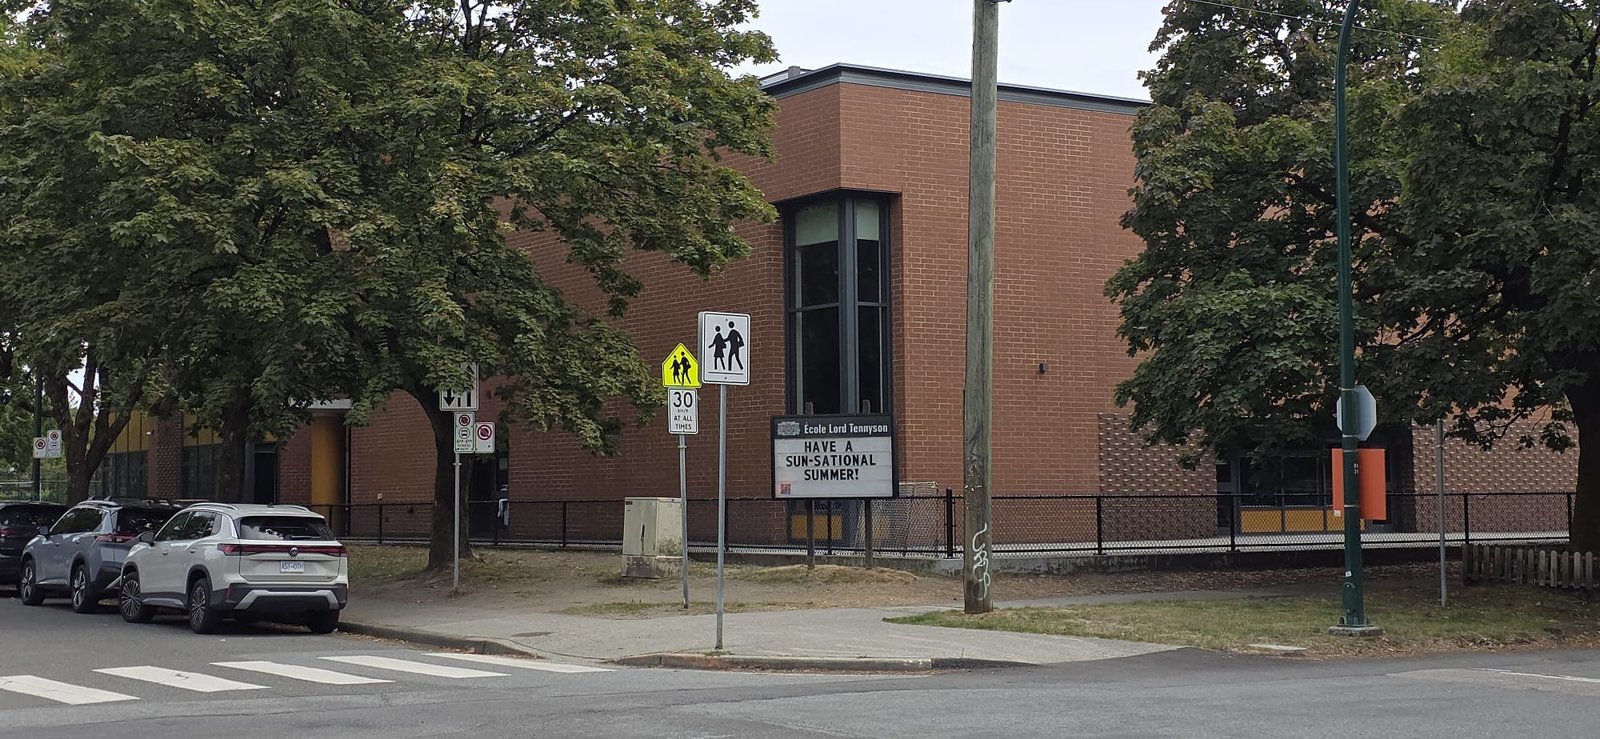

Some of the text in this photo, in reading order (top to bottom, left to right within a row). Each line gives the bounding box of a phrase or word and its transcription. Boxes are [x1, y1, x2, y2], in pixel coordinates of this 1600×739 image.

[673, 391, 693, 408] 30
[804, 422, 888, 435] École Lord Tennyson
[804, 440, 853, 453] HAVE A
[786, 454, 876, 467] SUN-SATIONAL
[804, 468, 859, 481] SUMMER!
